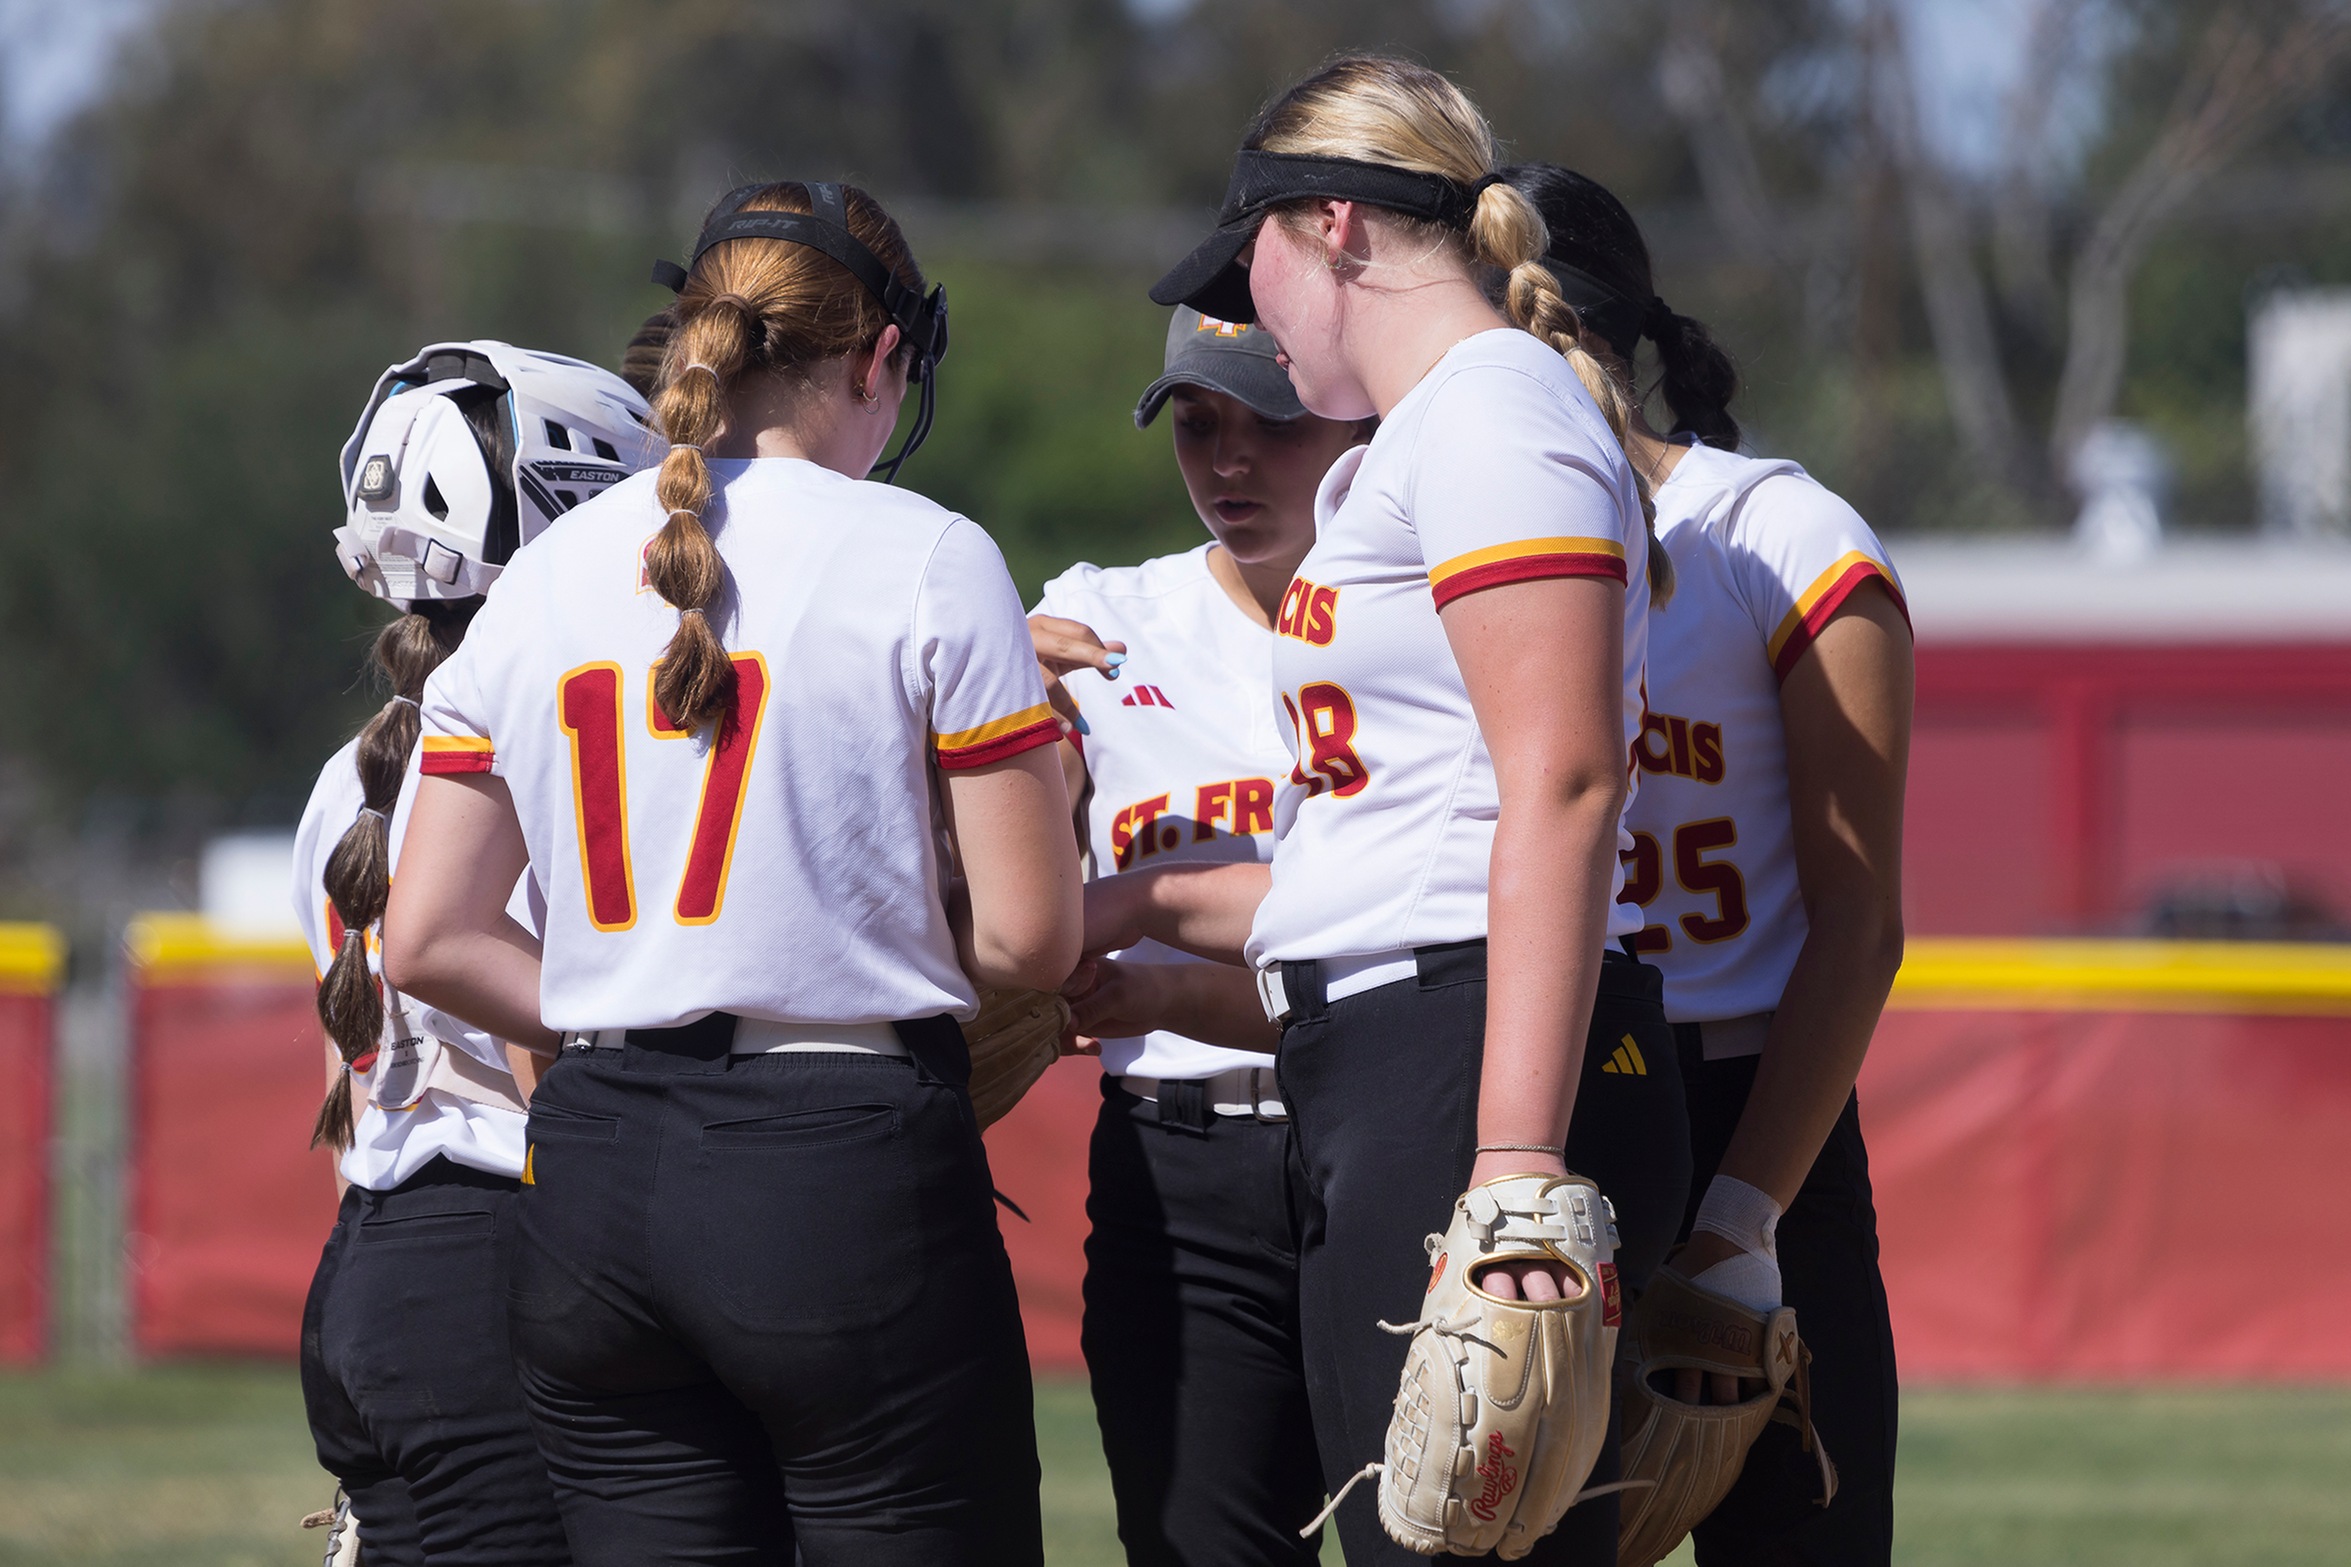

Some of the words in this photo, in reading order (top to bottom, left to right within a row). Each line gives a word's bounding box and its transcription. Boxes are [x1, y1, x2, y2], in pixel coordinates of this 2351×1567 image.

[727, 218, 800, 231] RIP-IT
[569, 470, 620, 482] EASTON
[1274, 575, 1341, 648] CIS
[1281, 680, 1371, 799] 18
[1630, 711, 1726, 786] CIS
[556, 650, 771, 932] 17
[1111, 791, 1181, 873] ST.
[1191, 775, 1276, 845] FR
[1615, 816, 1751, 955] 25
[390, 1036, 424, 1051] EASTON
[1470, 1429, 1516, 1522] Rawlings
